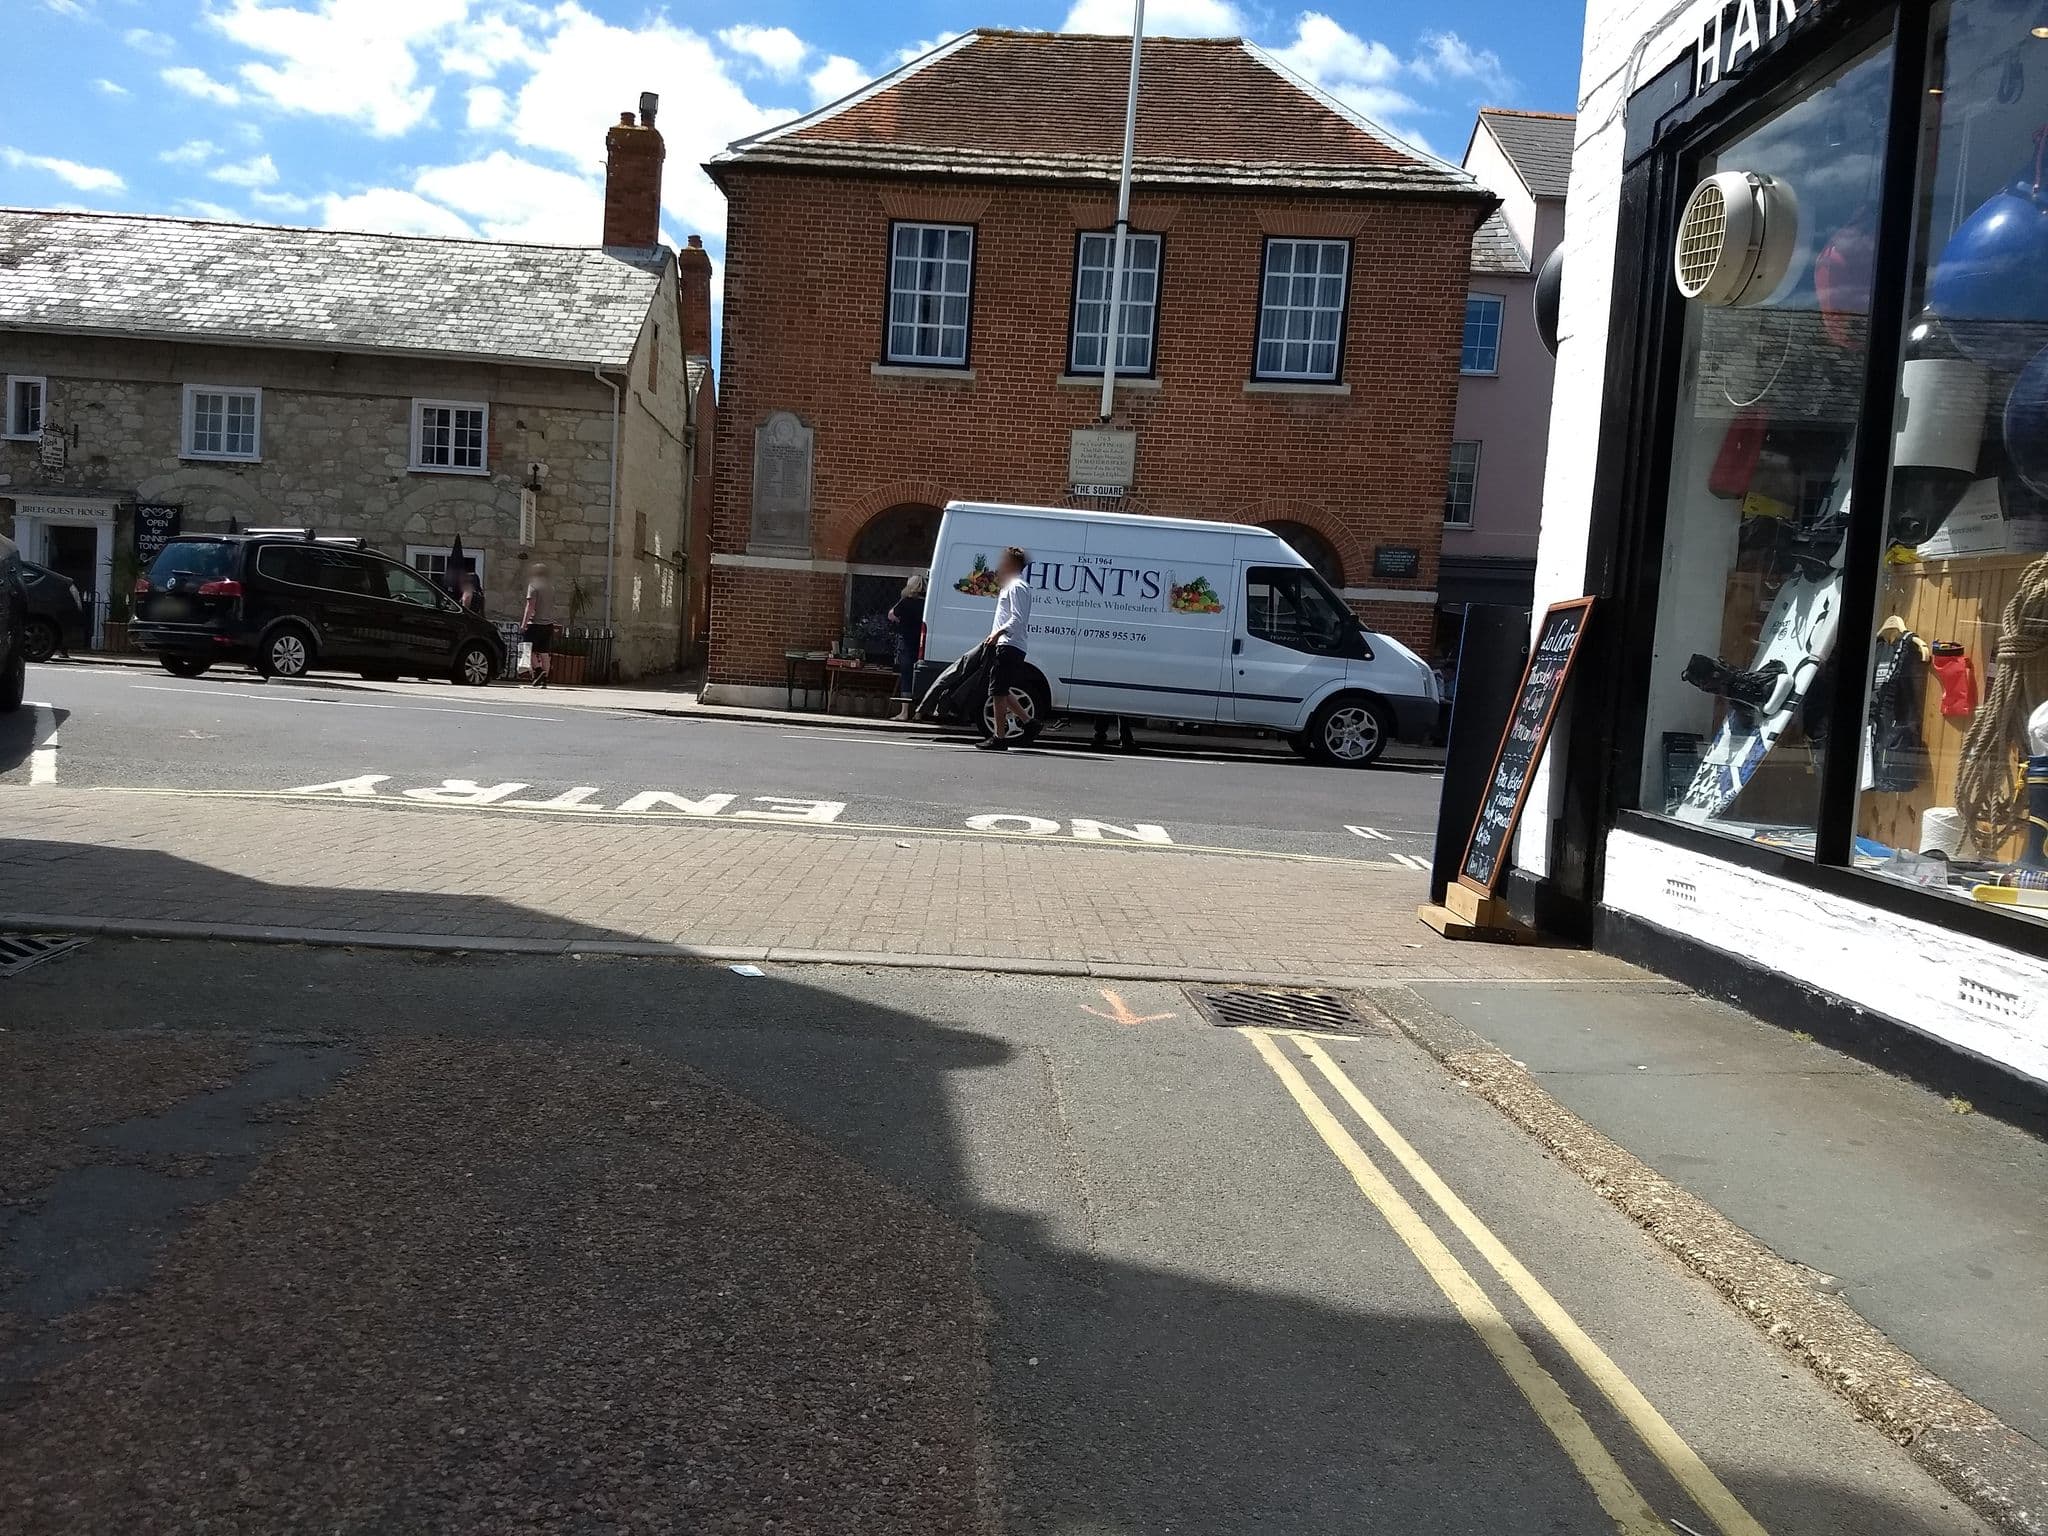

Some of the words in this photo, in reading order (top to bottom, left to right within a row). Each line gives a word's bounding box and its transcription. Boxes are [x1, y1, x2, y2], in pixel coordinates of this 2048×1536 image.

[1076, 486, 1091, 494] THE
[1093, 487, 1123, 496] SQUARE
[21, 505, 44, 513] JIREH
[47, 506, 75, 515] GUEST
[78, 507, 107, 517] HOUSE
[1078, 556, 1093, 564] Est.
[1095, 557, 1113, 565] 1964
[1027, 562, 1160, 599] HUNT'S
[1044, 596, 1053, 604] &
[1056, 597, 1101, 609] Vegetables
[1105, 601, 1158, 613] Wholesalers
[1044, 625, 1076, 636] 840376
[1084, 629, 1110, 639] 07785
[1112, 631, 1128, 640] 955
[1130, 633, 1147, 642] 376
[286, 774, 847, 823] ENTRY
[964, 814, 1174, 845] NO
